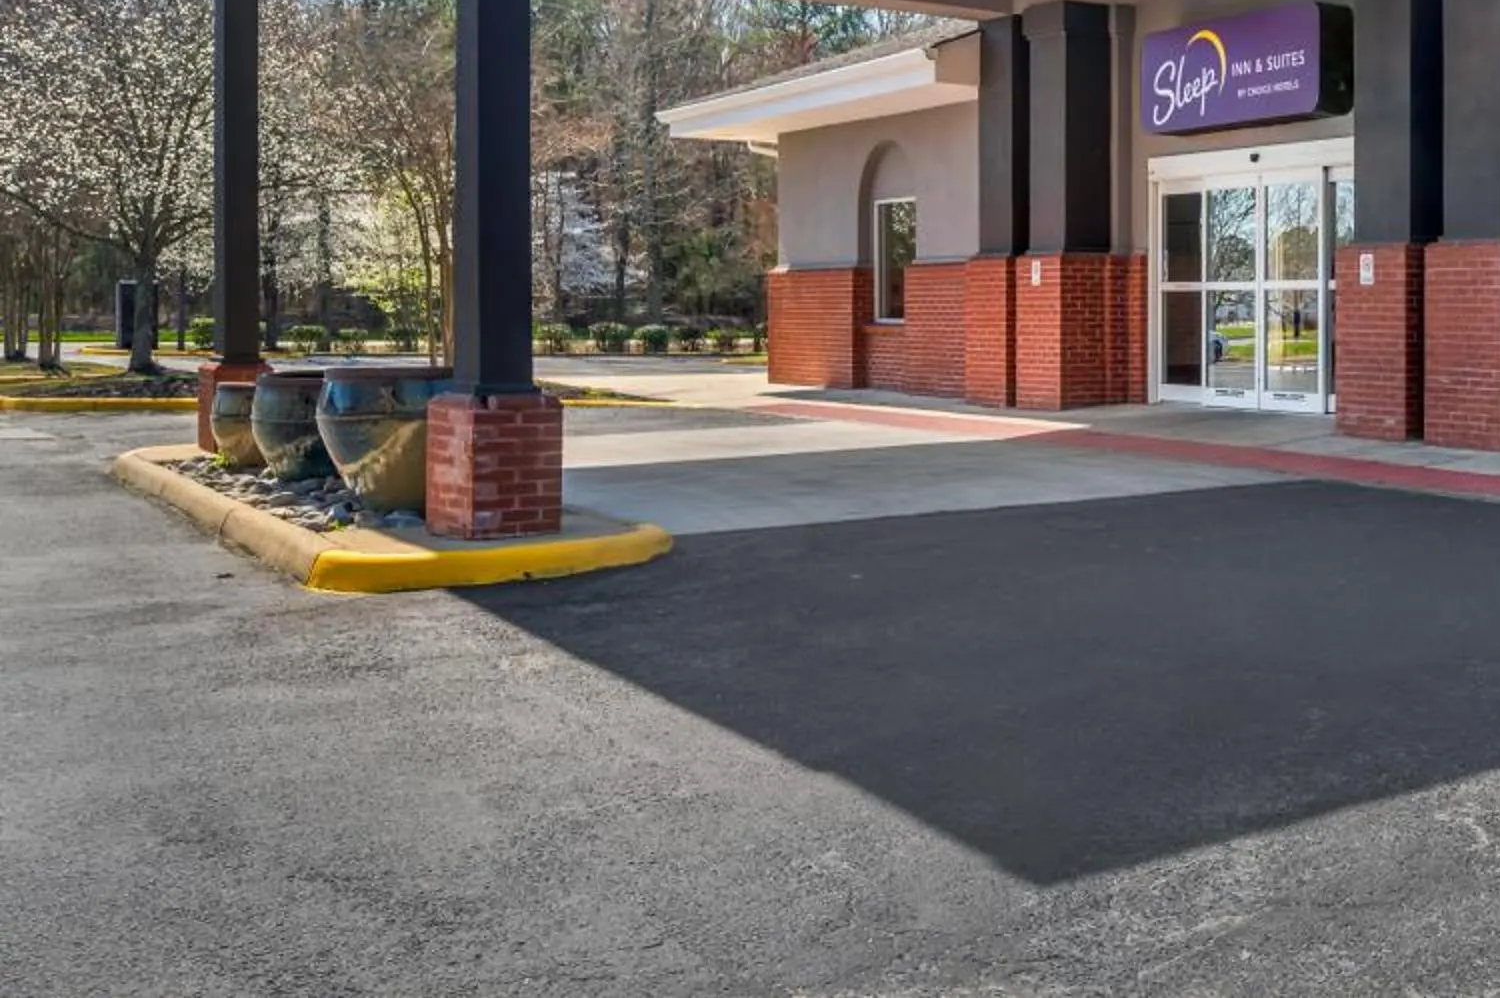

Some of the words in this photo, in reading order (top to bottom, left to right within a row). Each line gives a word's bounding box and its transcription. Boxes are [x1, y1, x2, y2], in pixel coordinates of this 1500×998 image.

[1231, 61, 1251, 77] INN
[1255, 58, 1263, 73] &
[1266, 50, 1305, 71] SUITES
[1153, 54, 1218, 126] Sleep
